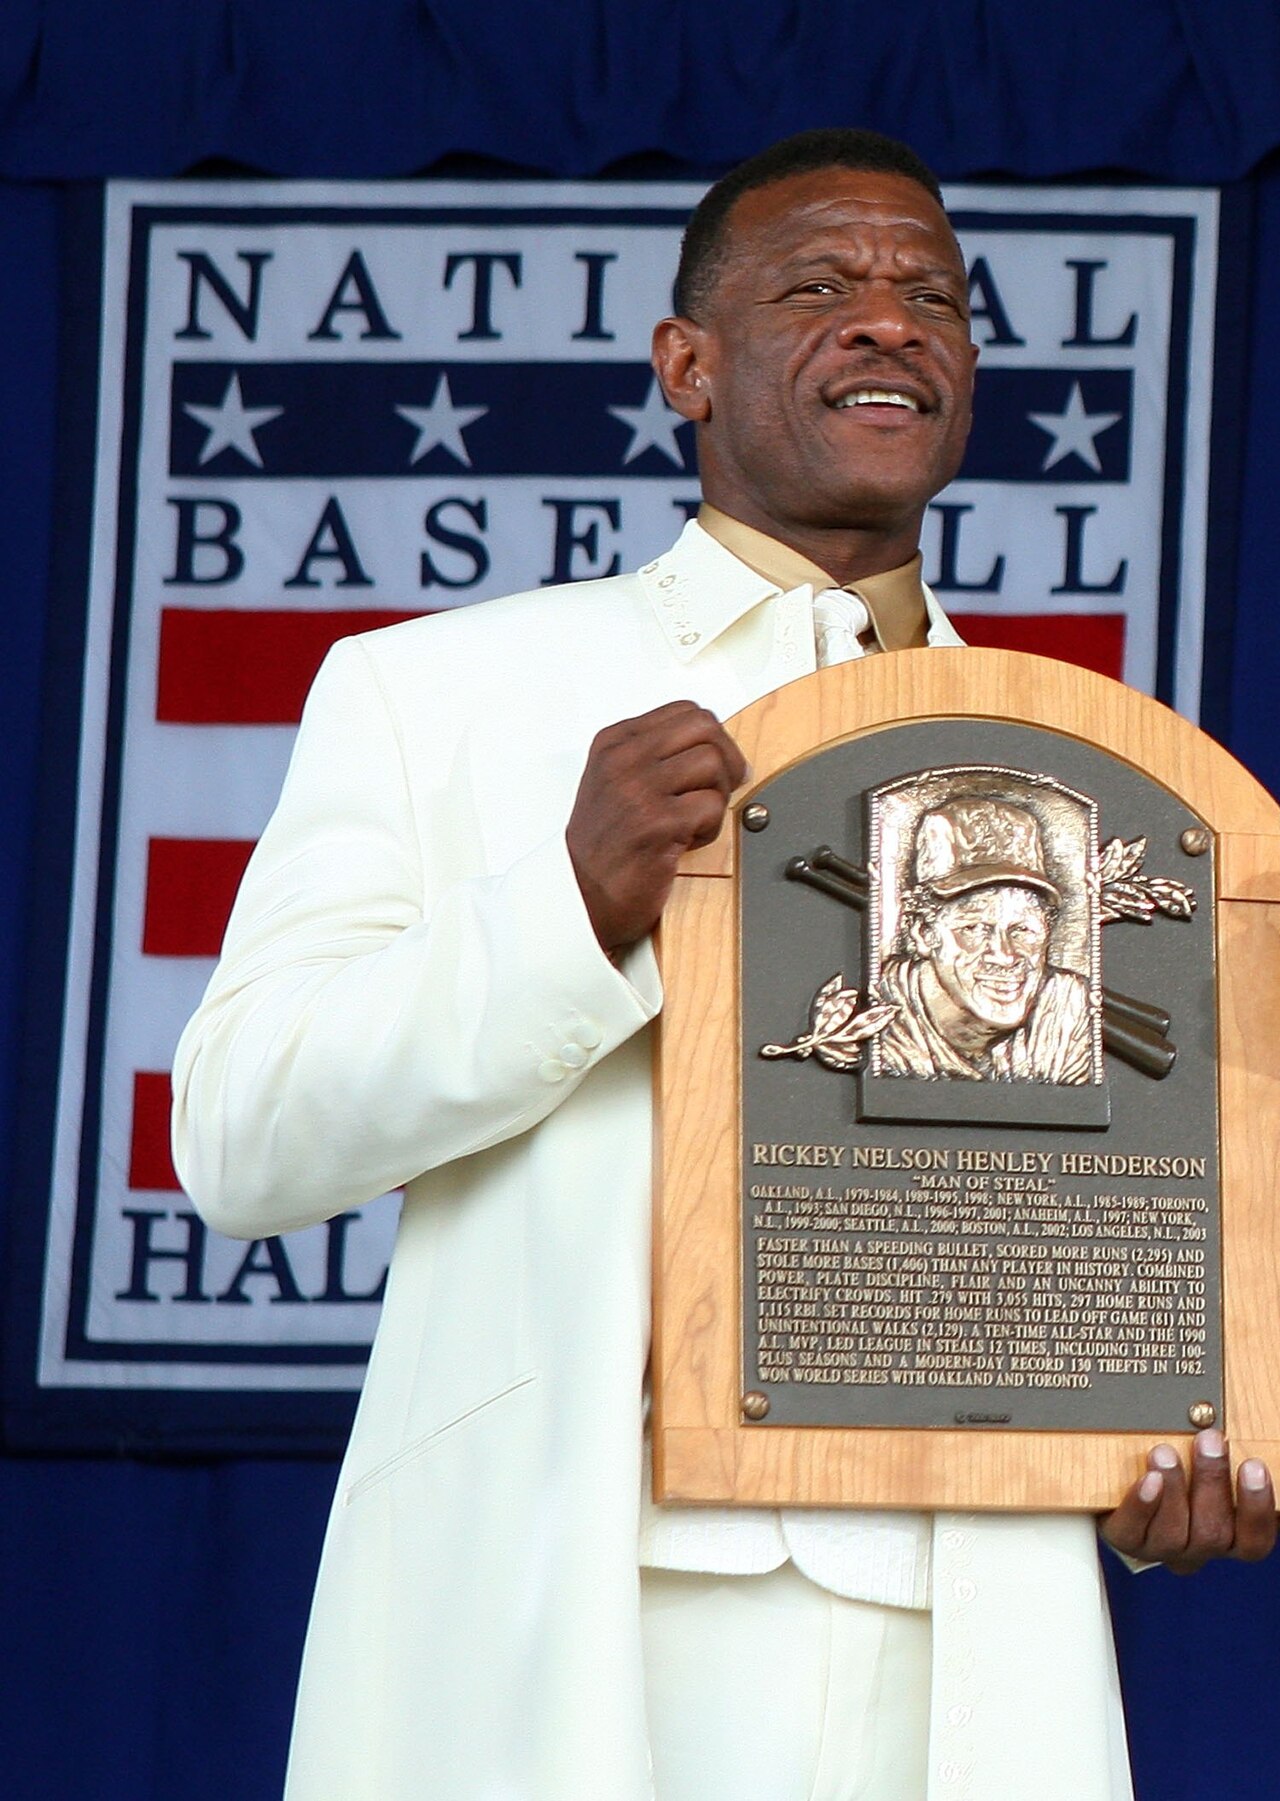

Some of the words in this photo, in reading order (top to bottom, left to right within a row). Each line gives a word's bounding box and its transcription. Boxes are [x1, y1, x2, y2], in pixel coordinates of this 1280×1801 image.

[174, 250, 1138, 348] NATIAL
[163, 496, 1128, 594] BASELL
[753, 1143, 847, 1167] RICKEY
[852, 1147, 950, 1170] NELSON
[956, 1149, 1054, 1173] HENLEY
[1061, 1152, 1207, 1177] HENDERSON
[966, 1176, 990, 1190] OF
[115, 1209, 390, 1304] HAL
[757, 1236, 809, 1252] FASTER
[812, 1238, 850, 1253] THAN
[853, 1240, 864, 1254] A
[867, 1240, 934, 1256] SPEEDING
[996, 1243, 1048, 1259] SCORED
[1051, 1245, 1089, 1260] MORE
[1092, 1246, 1128, 1261] RUNS
[1176, 1248, 1205, 1263] AND
[816, 1271, 860, 1286] PLATE
[951, 1274, 991, 1289] FLAIR
[997, 1276, 1027, 1290] AND
[1032, 1277, 1052, 1291] AN
[1058, 1277, 1124, 1293] UNCANNY
[1129, 1279, 1181, 1295] ABILITY
[1186, 1280, 1205, 1295] TO
[758, 1350, 793, 1366] PLUS
[799, 1351, 858, 1367] SEASONS
[863, 1353, 893, 1368] AND
[898, 1354, 909, 1368] A
[1010, 1356, 1065, 1371] RECORD
[1071, 1357, 1092, 1373] 130
[1097, 1358, 1148, 1374] THEFTS
[1152, 1359, 1168, 1374] IN
